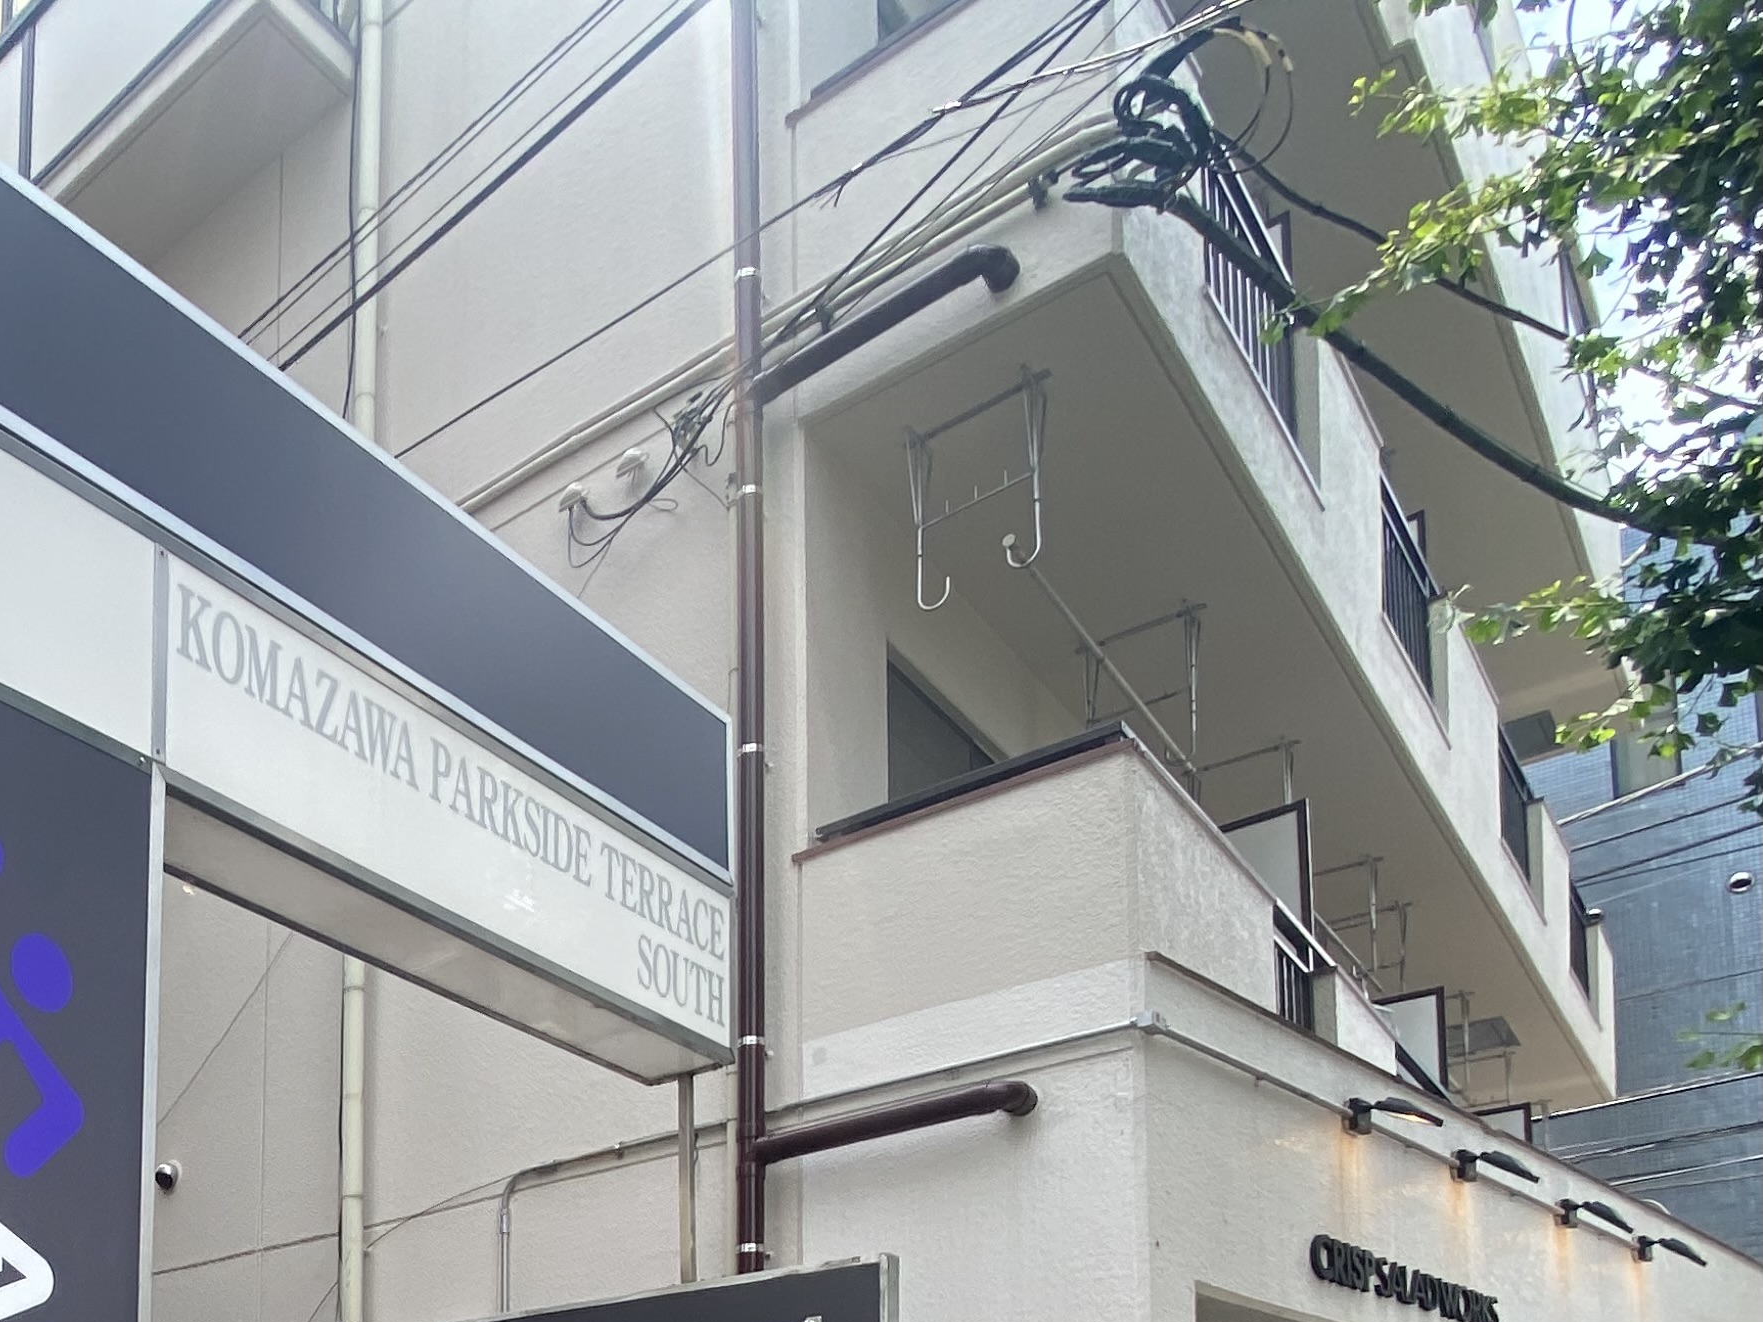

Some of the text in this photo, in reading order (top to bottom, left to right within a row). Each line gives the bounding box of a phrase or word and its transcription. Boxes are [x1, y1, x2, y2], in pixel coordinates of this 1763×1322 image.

[176, 583, 727, 962] KOMAZAWA PARKSIDE TERRACE
[638, 930, 726, 1028] SOUTH
[1310, 1234, 1375, 1292] CRISP
[1374, 1257, 1438, 1311] SALAD
